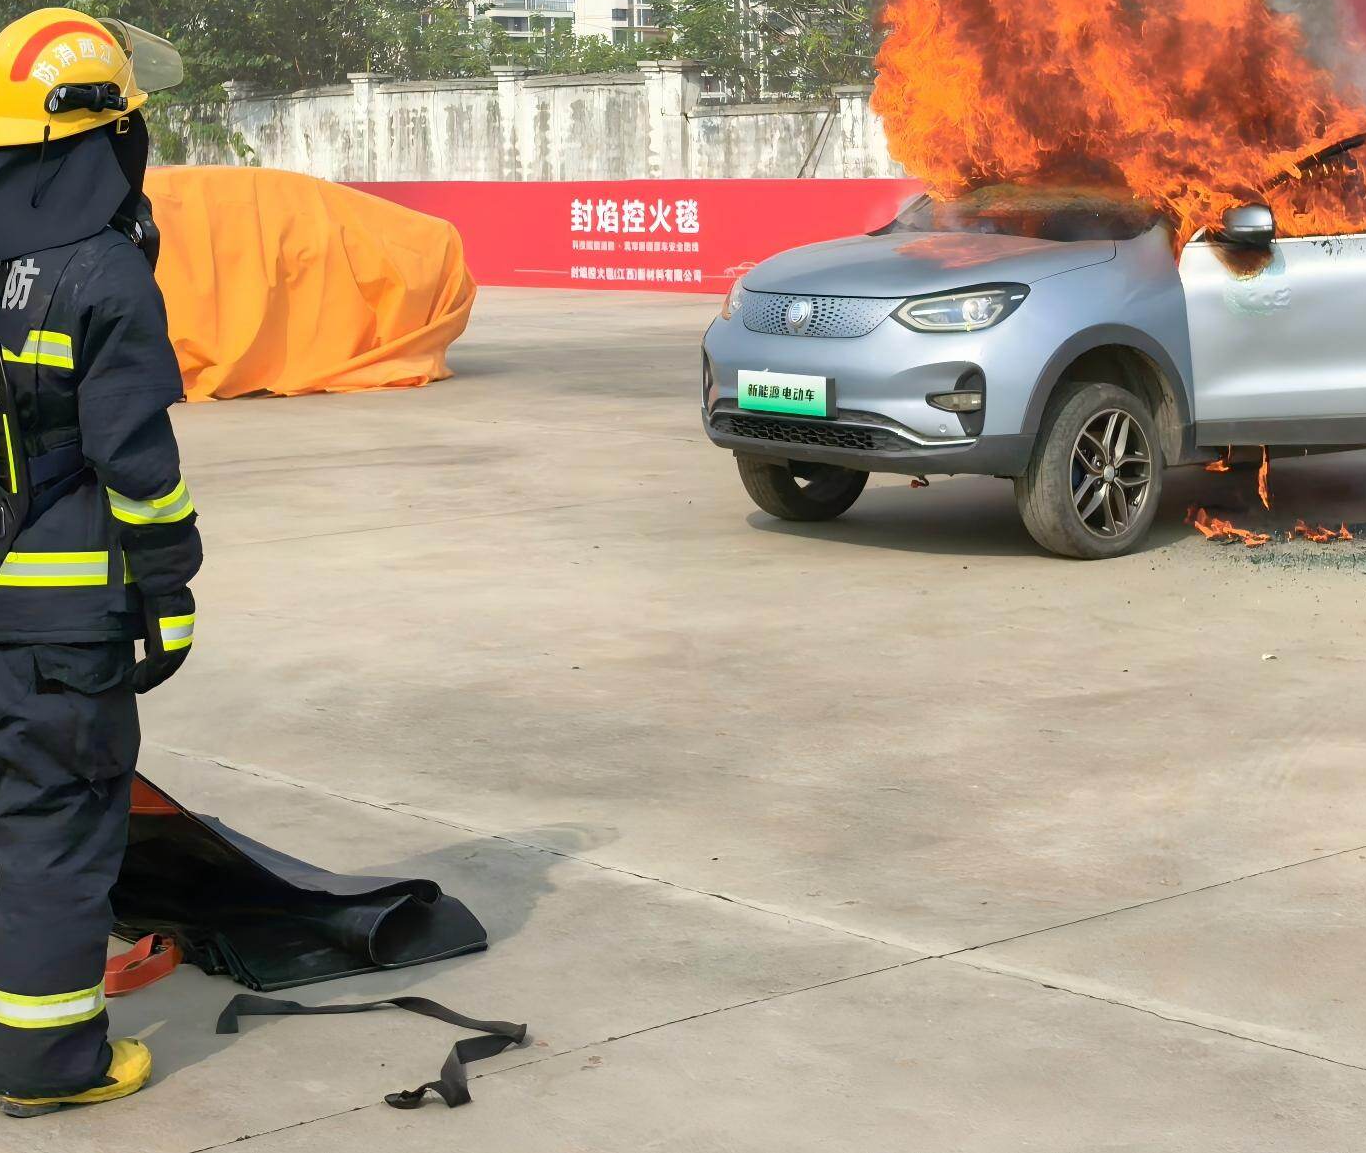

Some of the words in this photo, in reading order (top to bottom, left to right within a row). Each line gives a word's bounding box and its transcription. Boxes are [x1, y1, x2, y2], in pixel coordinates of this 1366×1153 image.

[570, 199, 700, 234] 封焰控火毯
